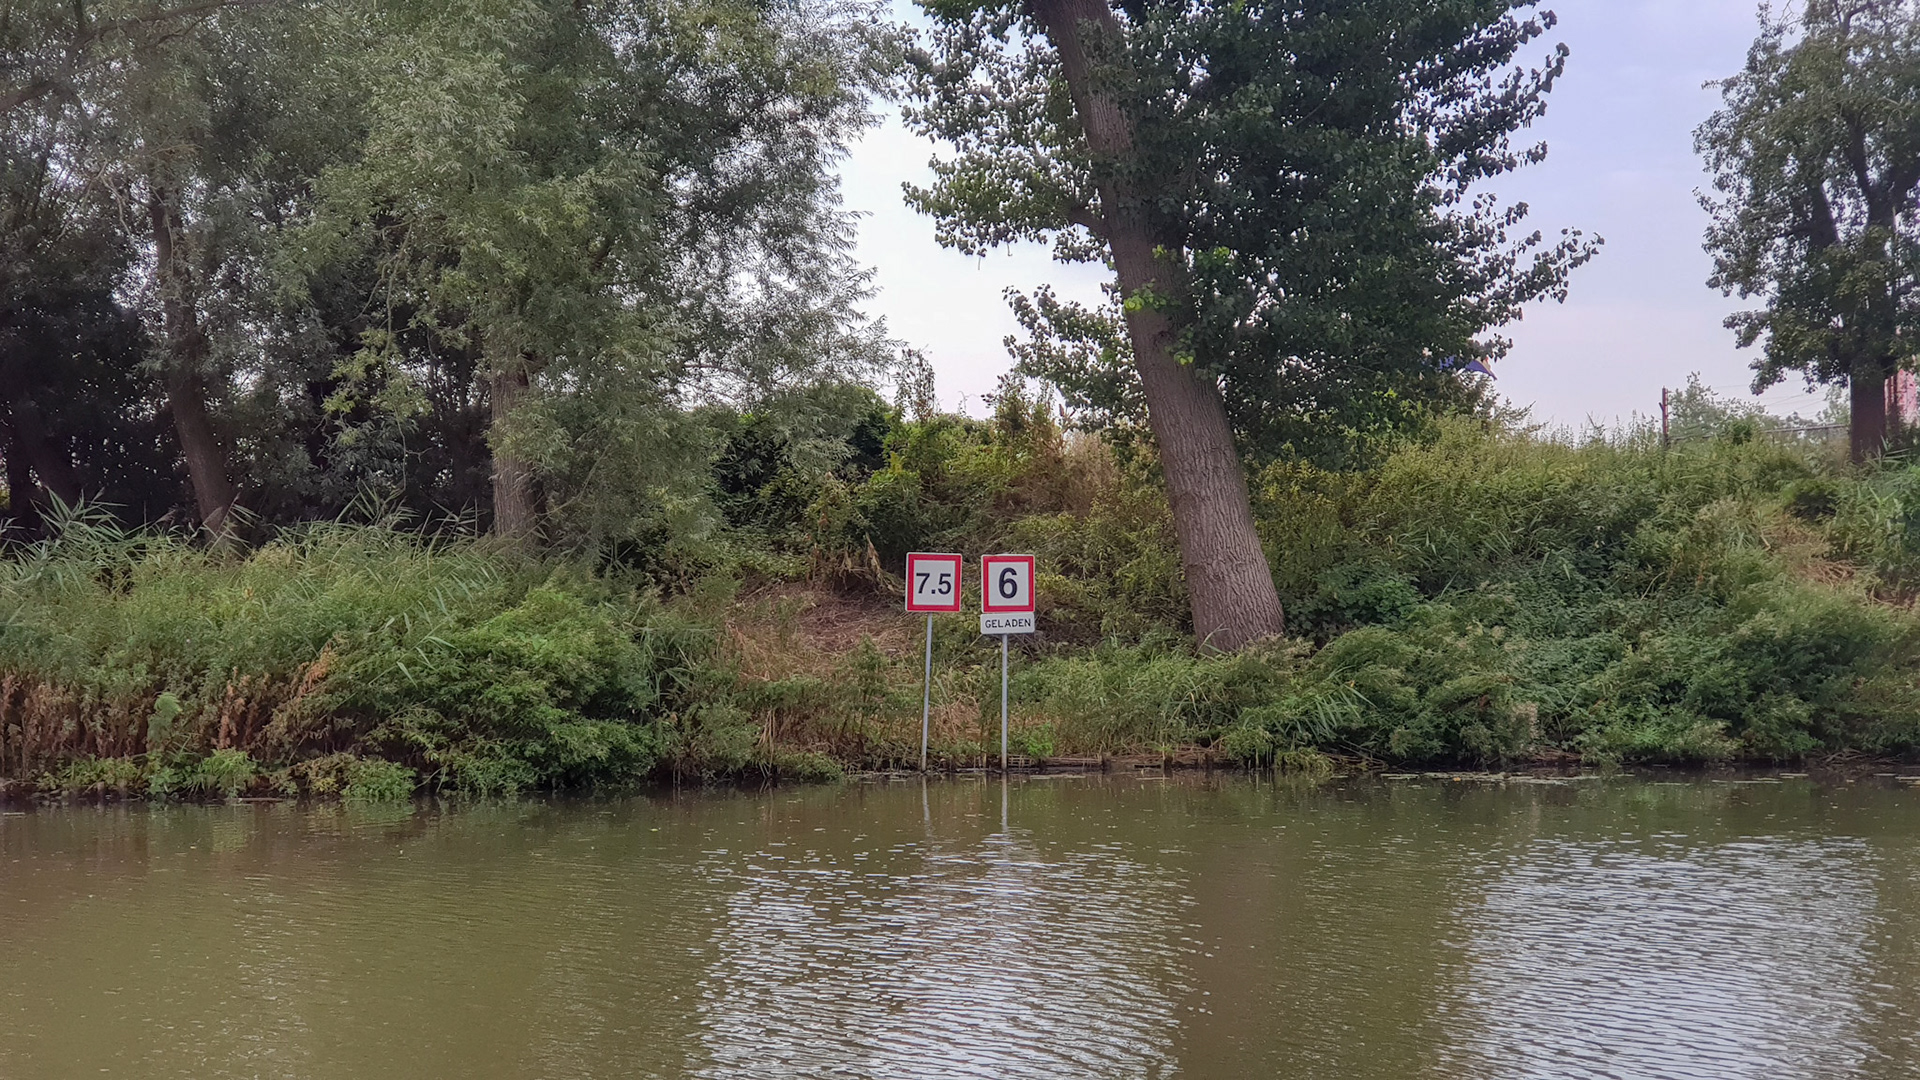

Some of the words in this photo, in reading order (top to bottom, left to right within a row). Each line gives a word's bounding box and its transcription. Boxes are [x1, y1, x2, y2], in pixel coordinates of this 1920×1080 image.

[916, 573, 952, 595] 7.5
[998, 567, 1018, 599] 6
[985, 618, 1031, 628] GELADEN
